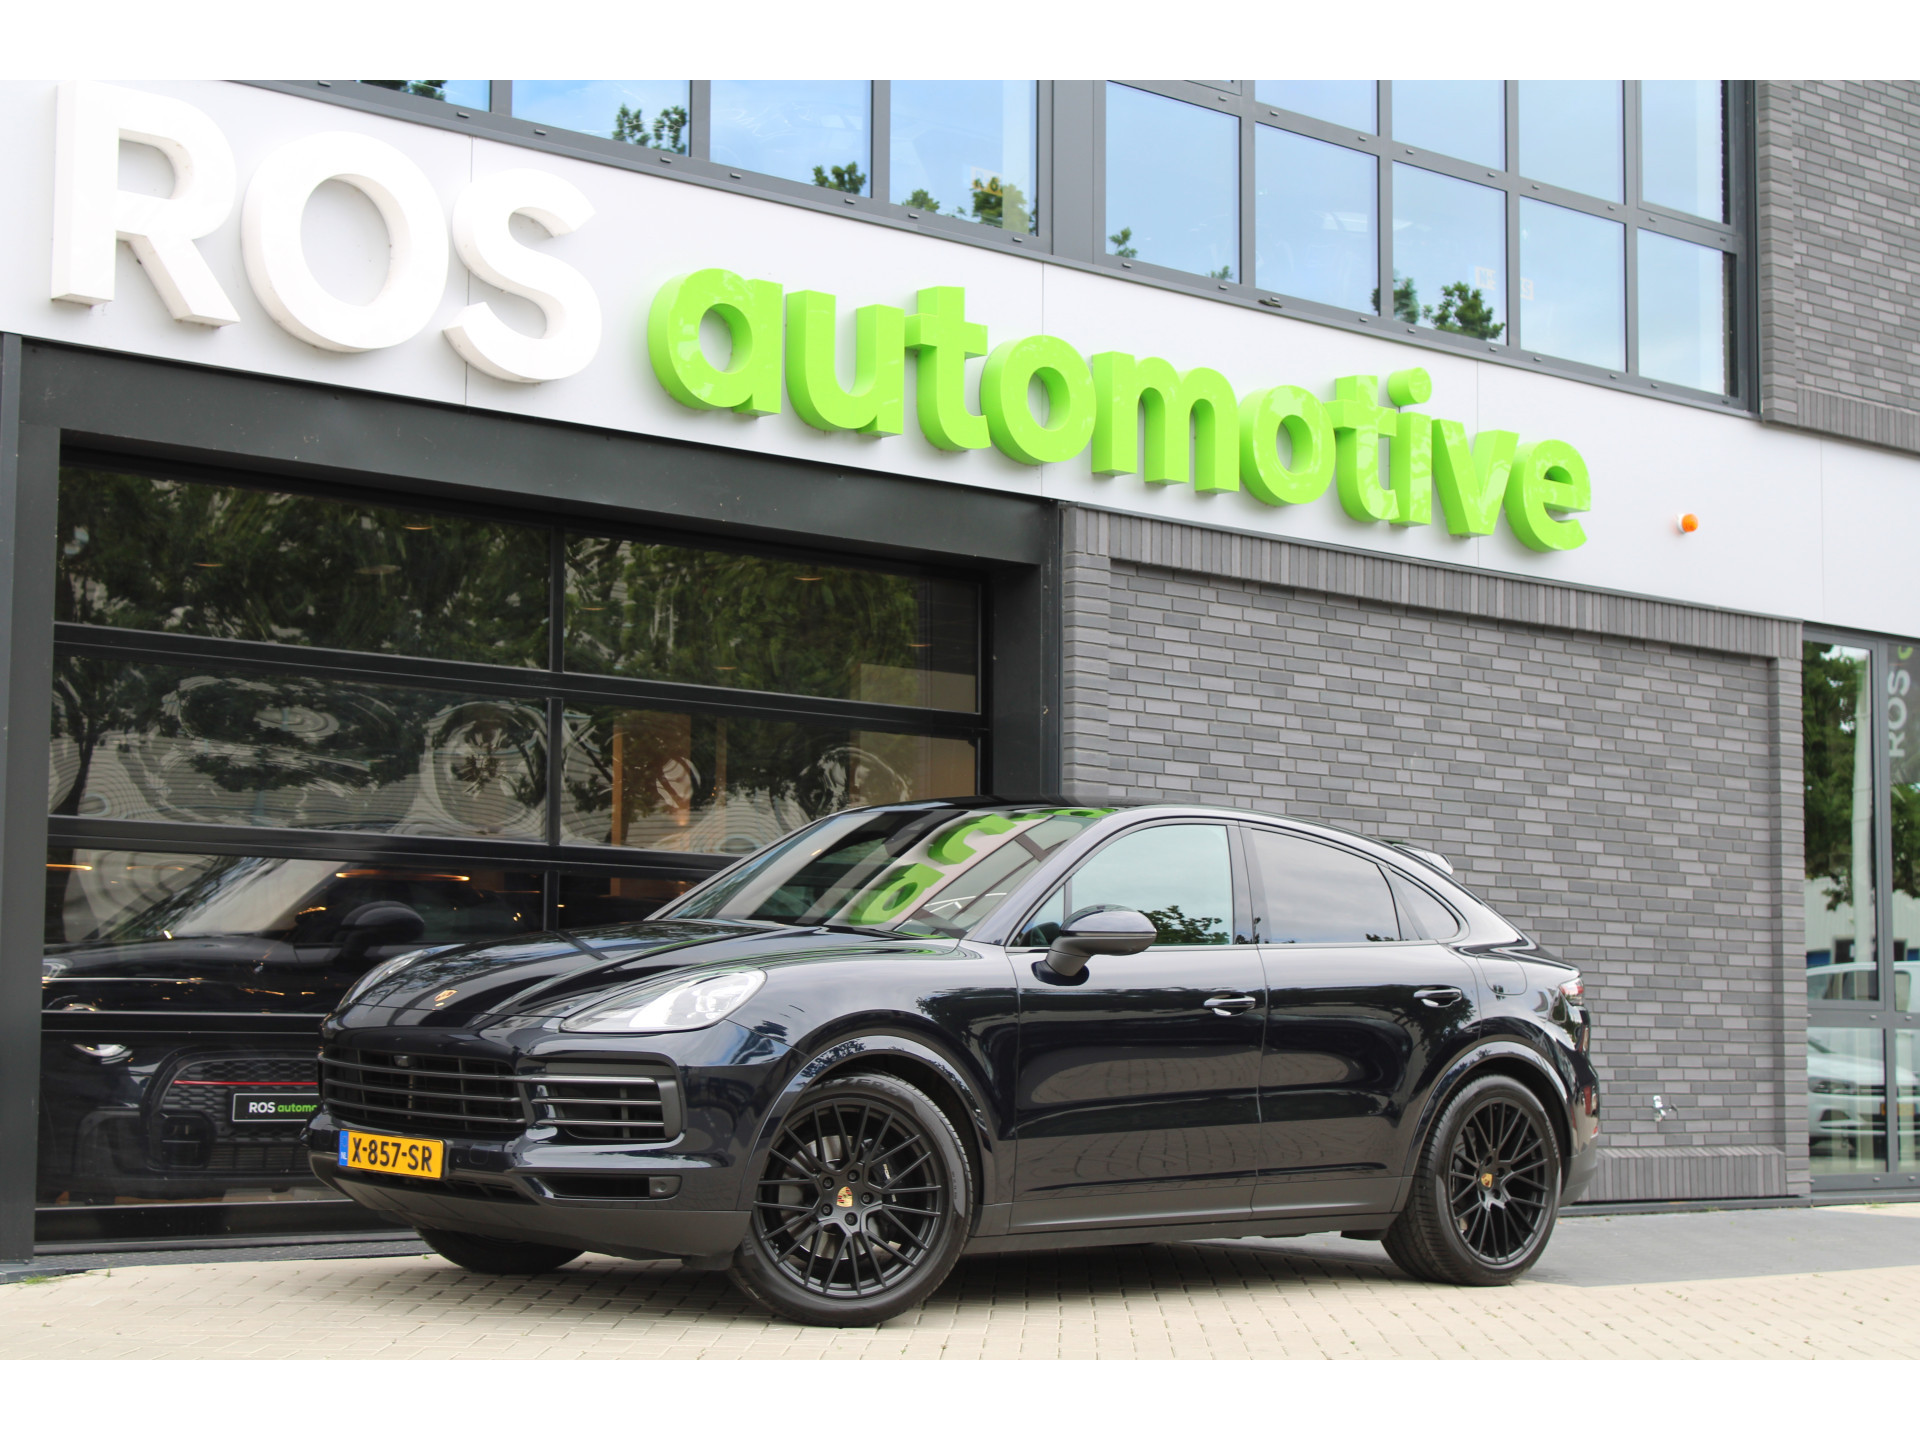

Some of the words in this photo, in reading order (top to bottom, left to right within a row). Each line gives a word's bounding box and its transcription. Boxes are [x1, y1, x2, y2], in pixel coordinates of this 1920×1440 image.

[51, 80, 601, 384] ROS
[648, 267, 1592, 553] automotive
[1888, 669, 1911, 757] ROS
[249, 1101, 276, 1114] ROS
[352, 1137, 433, 1172] X-857-SR
